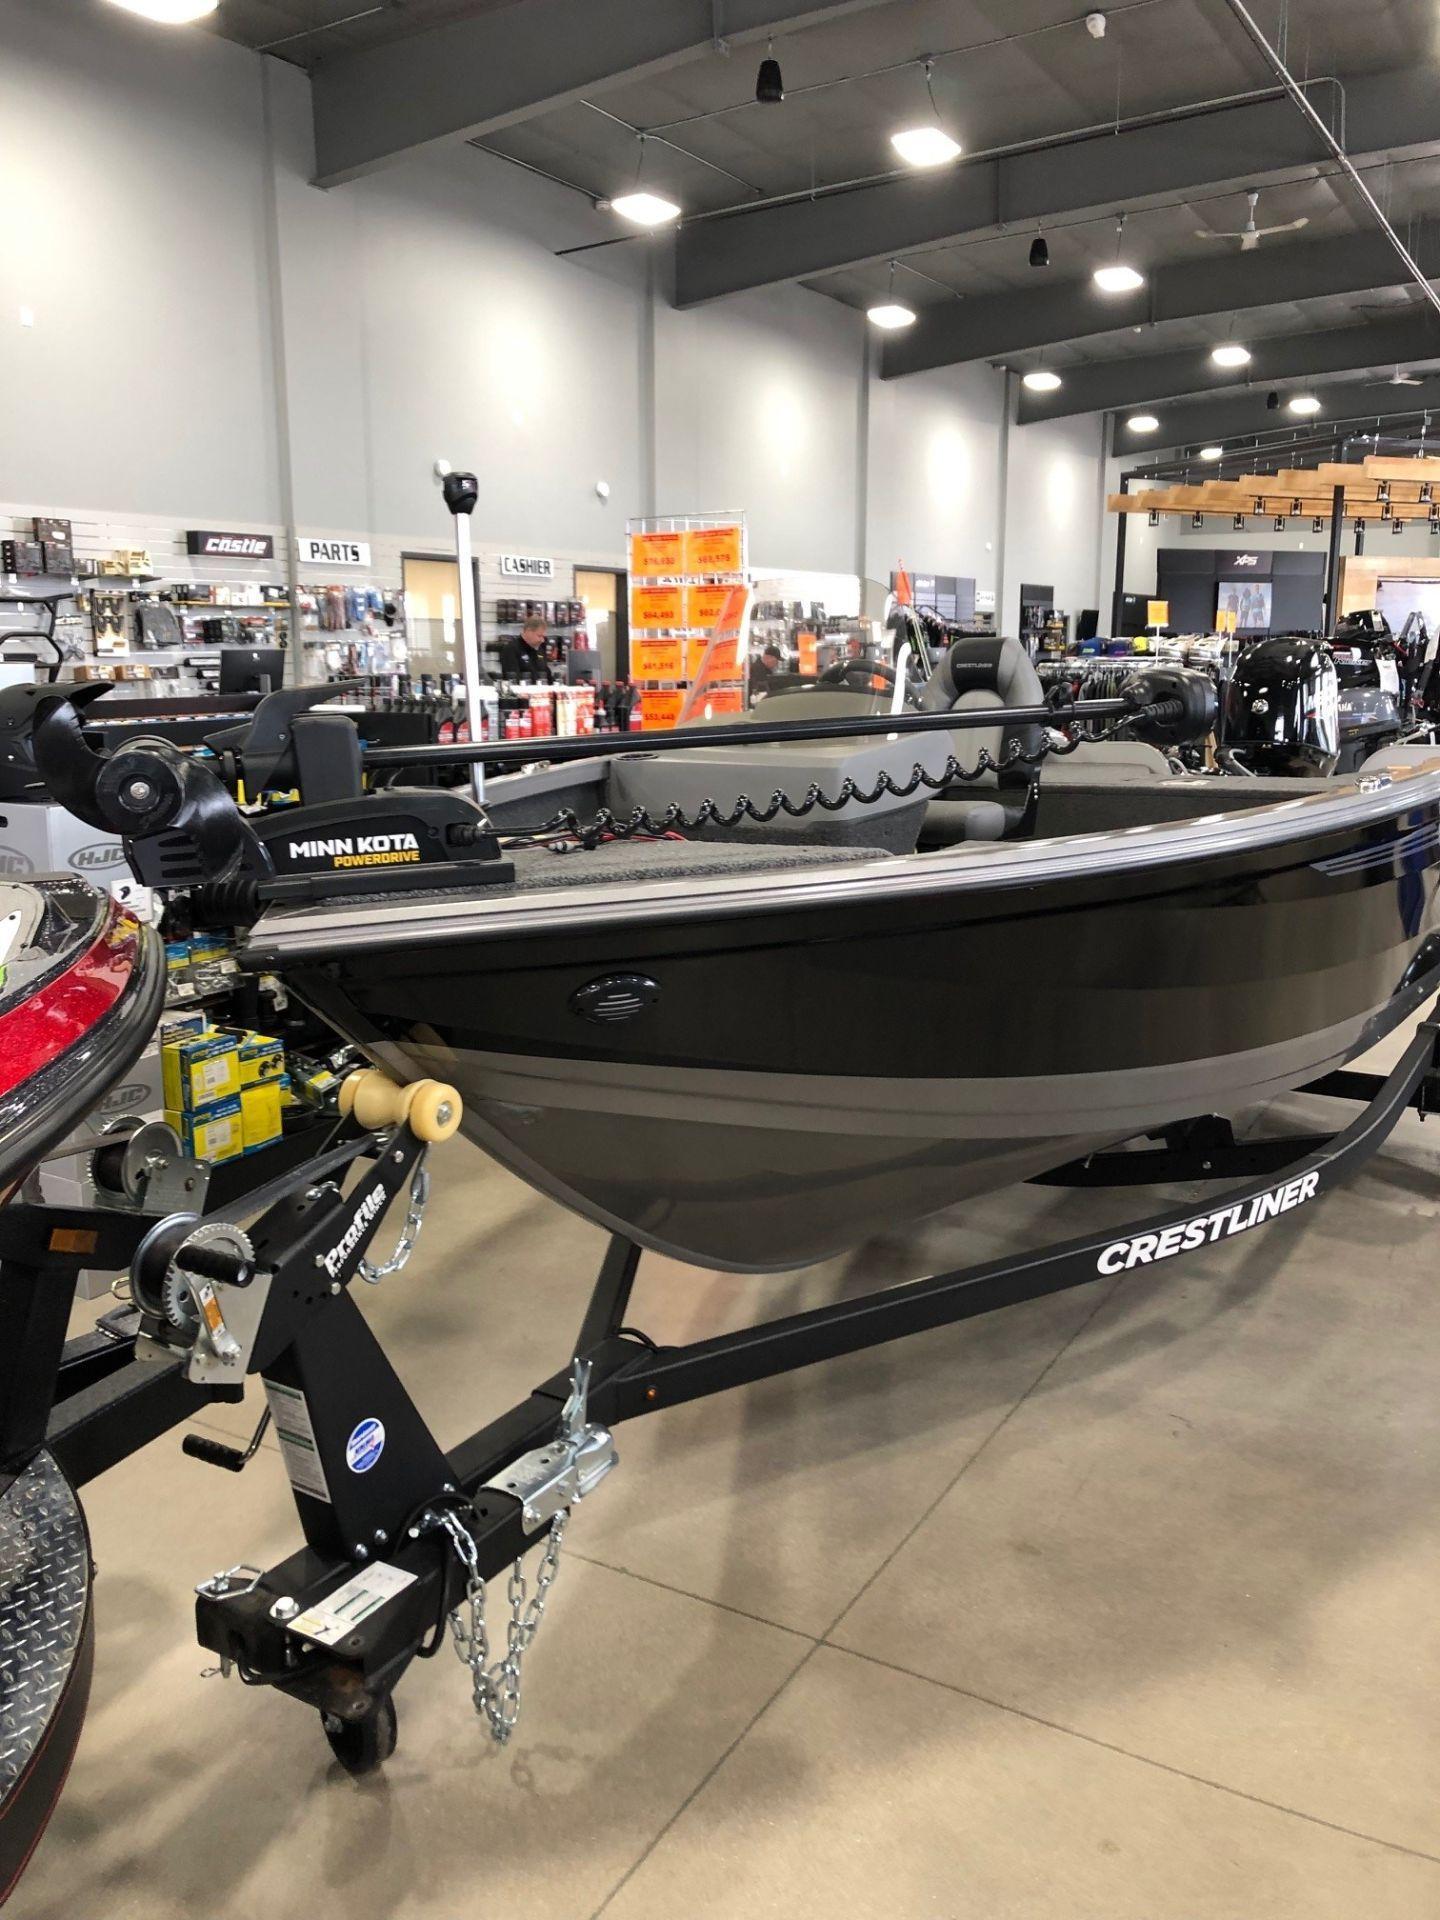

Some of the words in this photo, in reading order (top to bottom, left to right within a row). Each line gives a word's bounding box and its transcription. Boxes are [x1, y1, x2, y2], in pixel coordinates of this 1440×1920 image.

[310, 542, 360, 562] PARTS
[504, 557, 551, 575] CASHIER
[289, 838, 354, 859] MINN
[356, 833, 420, 853] KOTA
[333, 850, 420, 867] POWERDRIVE
[324, 1183, 387, 1278] Profile
[1097, 1171, 1320, 1275] CRESTLINER
